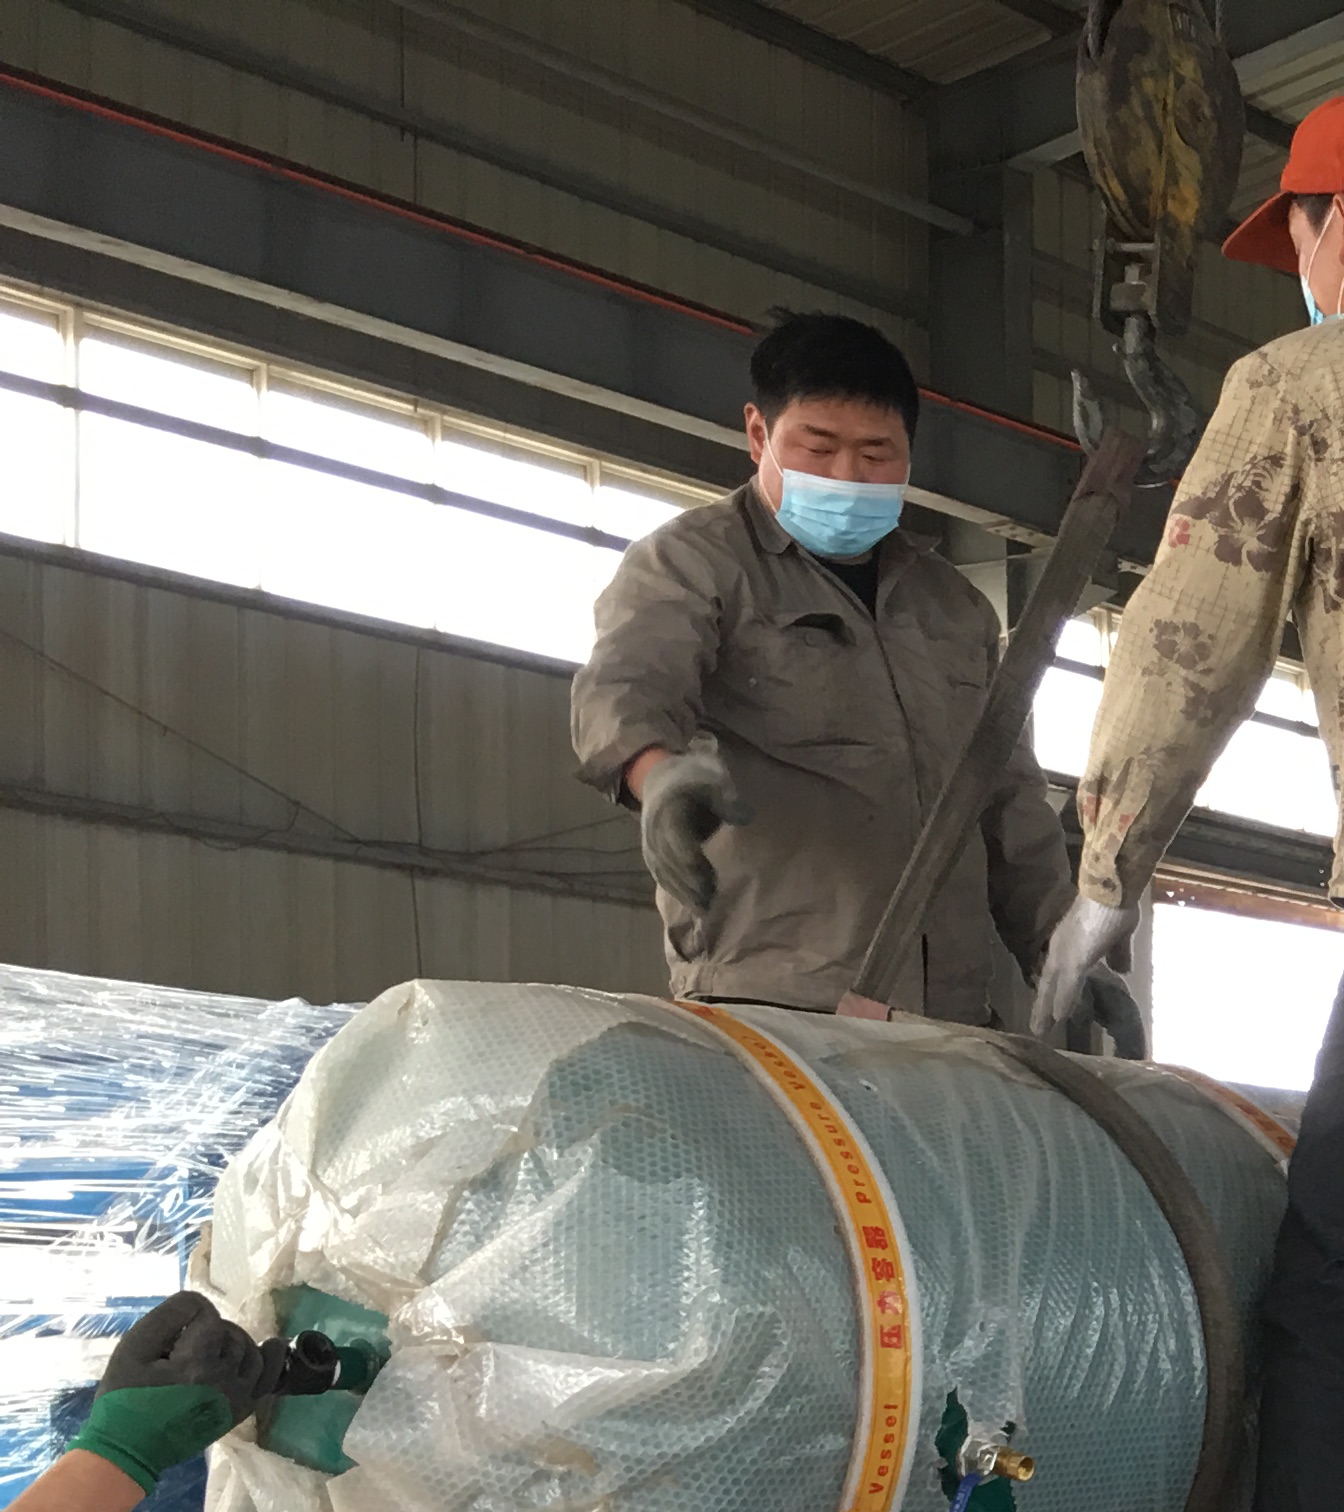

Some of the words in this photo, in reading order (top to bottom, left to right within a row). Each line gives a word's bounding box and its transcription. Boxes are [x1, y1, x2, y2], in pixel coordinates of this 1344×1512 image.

[862, 1225, 904, 1351] 压力容器
[868, 1403, 899, 1495] Vessel
